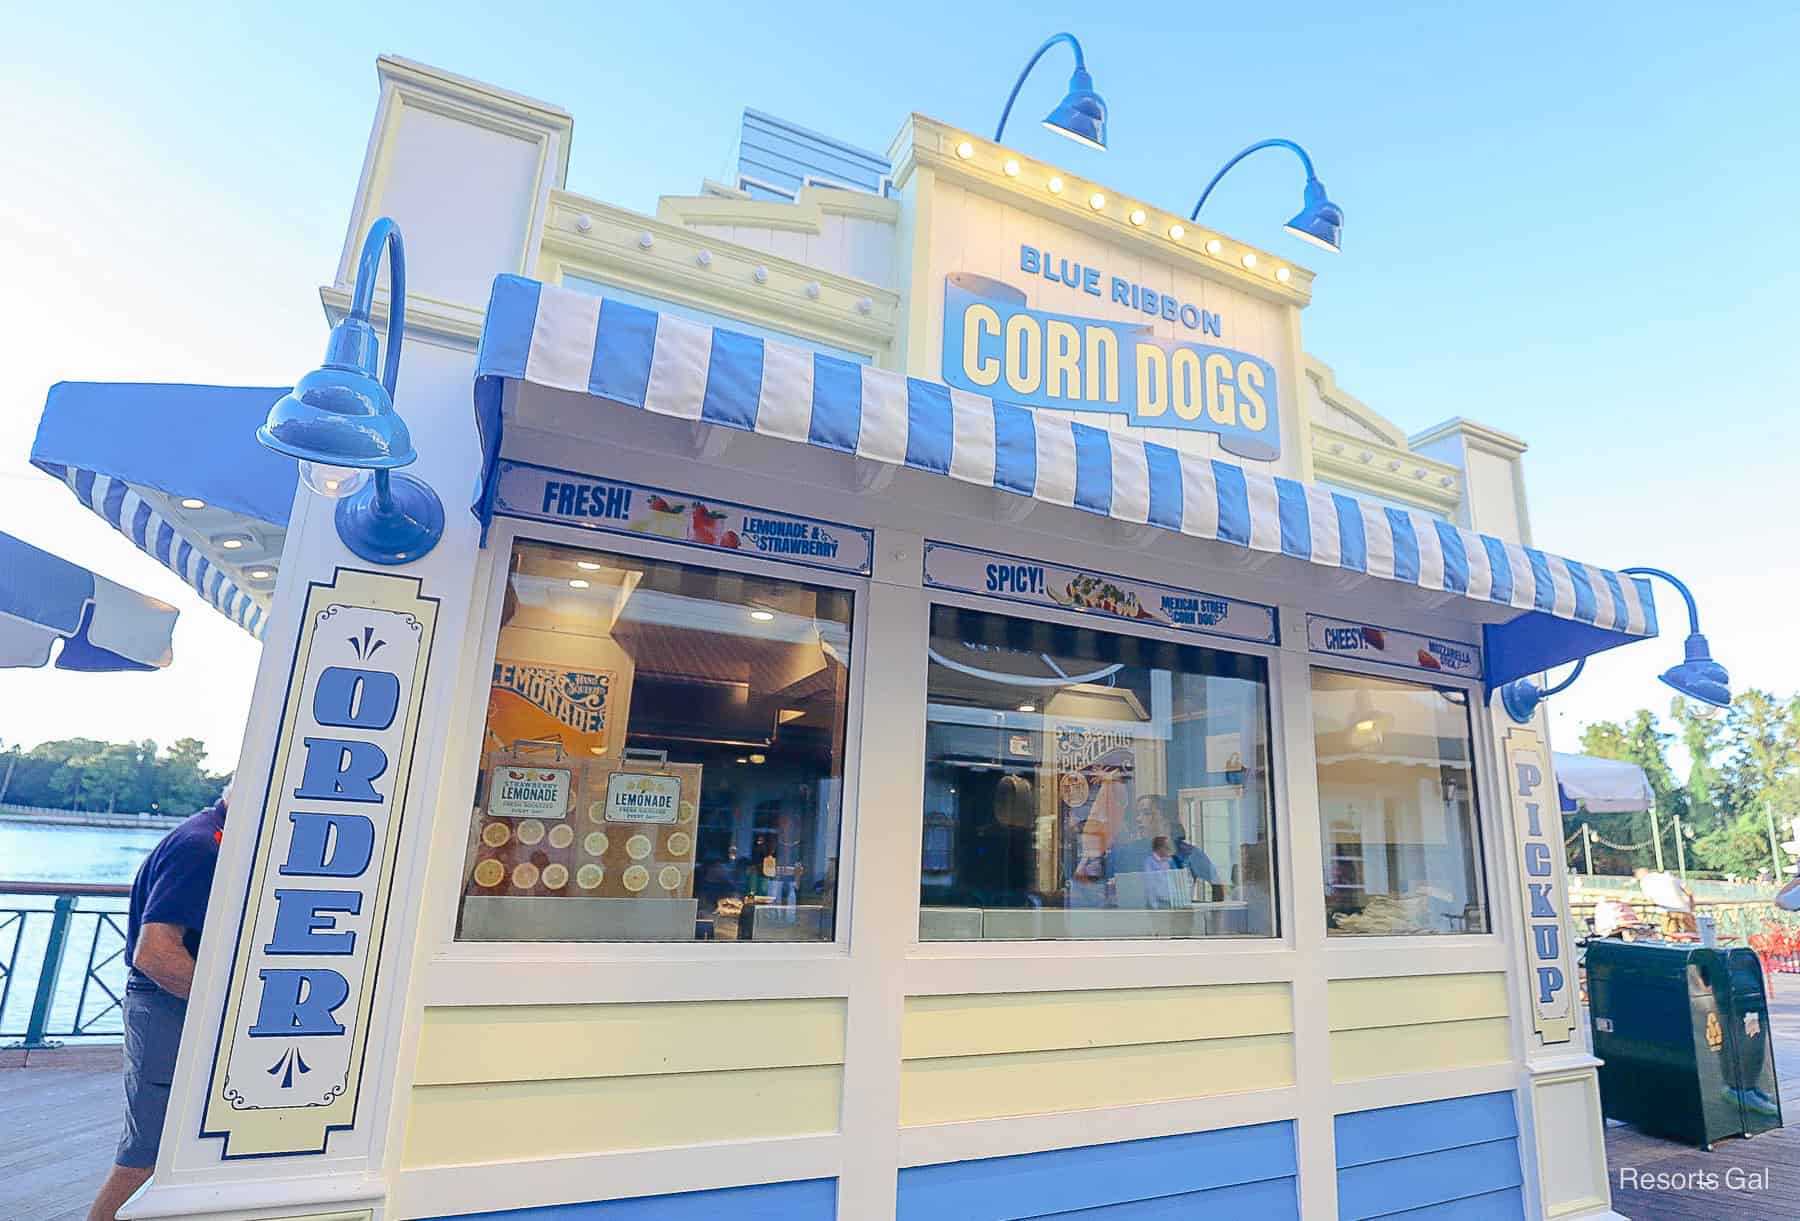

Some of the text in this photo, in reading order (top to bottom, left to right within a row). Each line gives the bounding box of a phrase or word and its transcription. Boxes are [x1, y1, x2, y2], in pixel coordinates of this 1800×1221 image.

[1020, 244, 1221, 337] BLUE RIBBON
[963, 303, 1267, 432] CORN DOGS
[542, 481, 632, 520] FRESH!
[742, 516, 820, 541] LEMONADE &
[759, 537, 839, 559] STRAWBERRY
[986, 562, 1044, 595] SPICY!
[1161, 596, 1228, 617] MEXICAN STREET
[502, 786, 558, 801] LEMONADE
[615, 793, 672, 808] LEMONADE
[247, 665, 400, 1037] ORDER
[1516, 763, 1564, 1003] PICKUP
